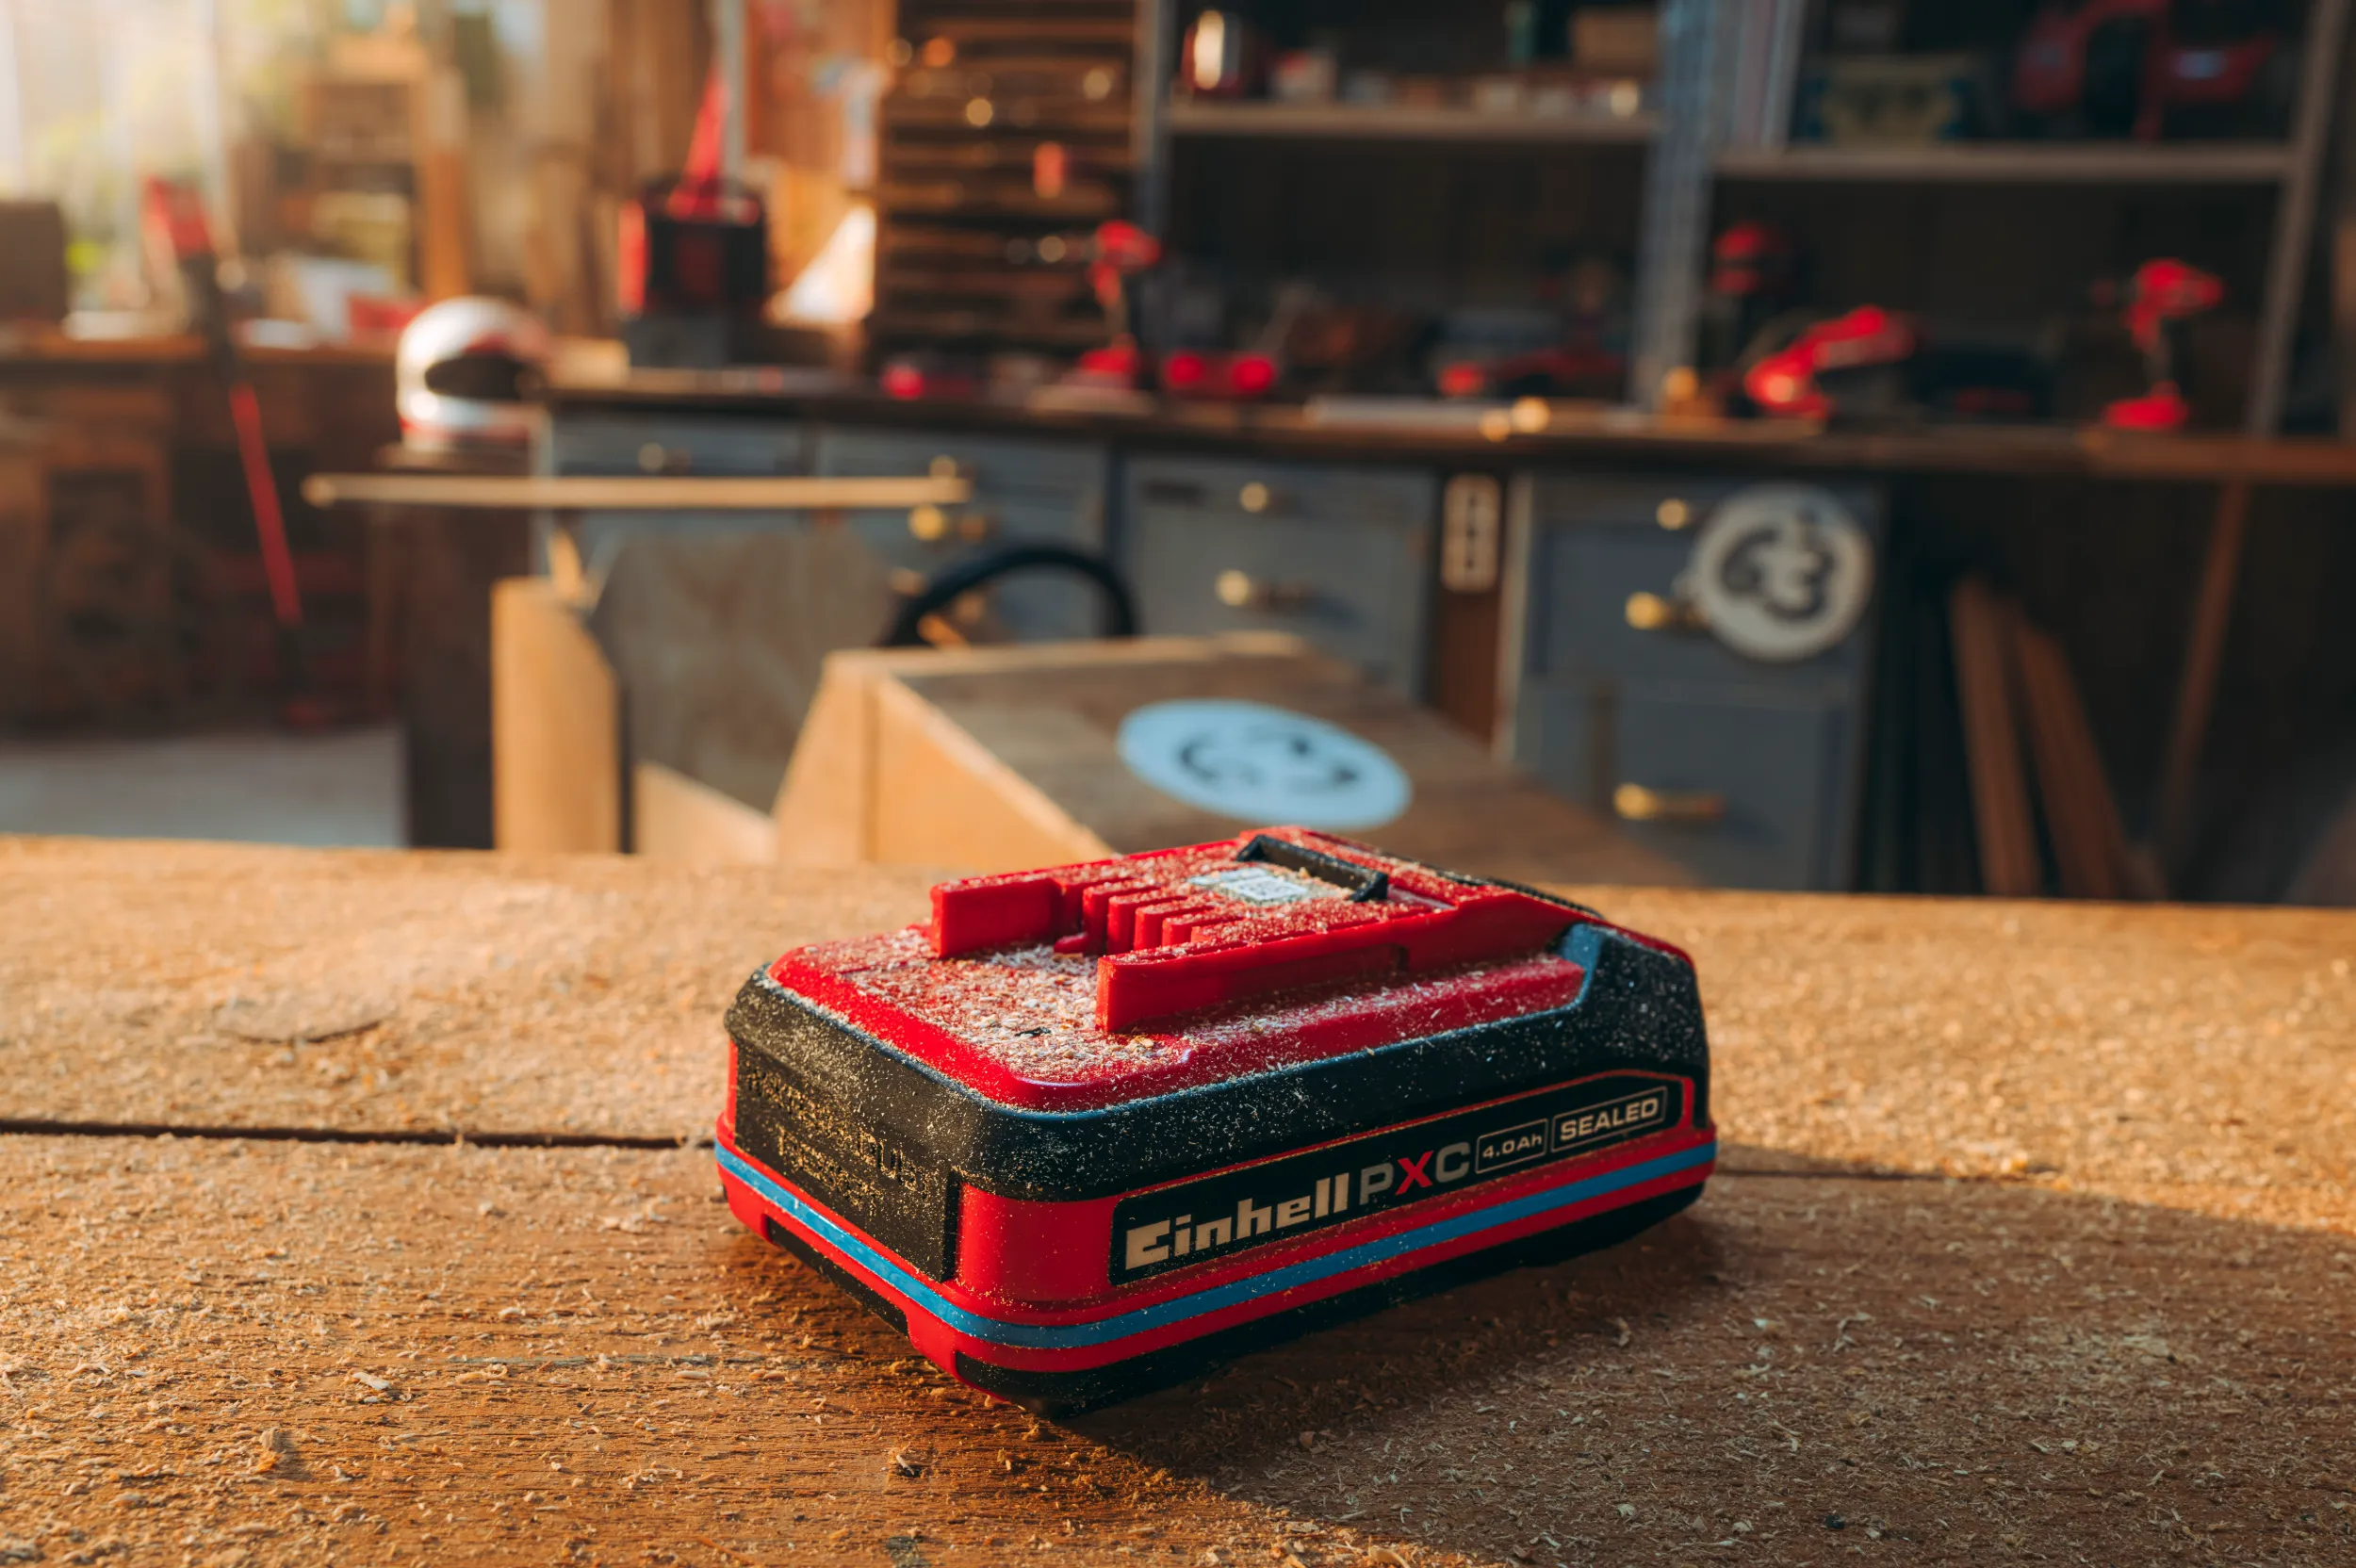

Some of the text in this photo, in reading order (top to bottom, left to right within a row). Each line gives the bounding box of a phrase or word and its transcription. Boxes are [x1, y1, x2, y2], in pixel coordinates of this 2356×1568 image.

[1125, 1098, 1659, 1270] Einhell PXC 4.0Ah SEALED
